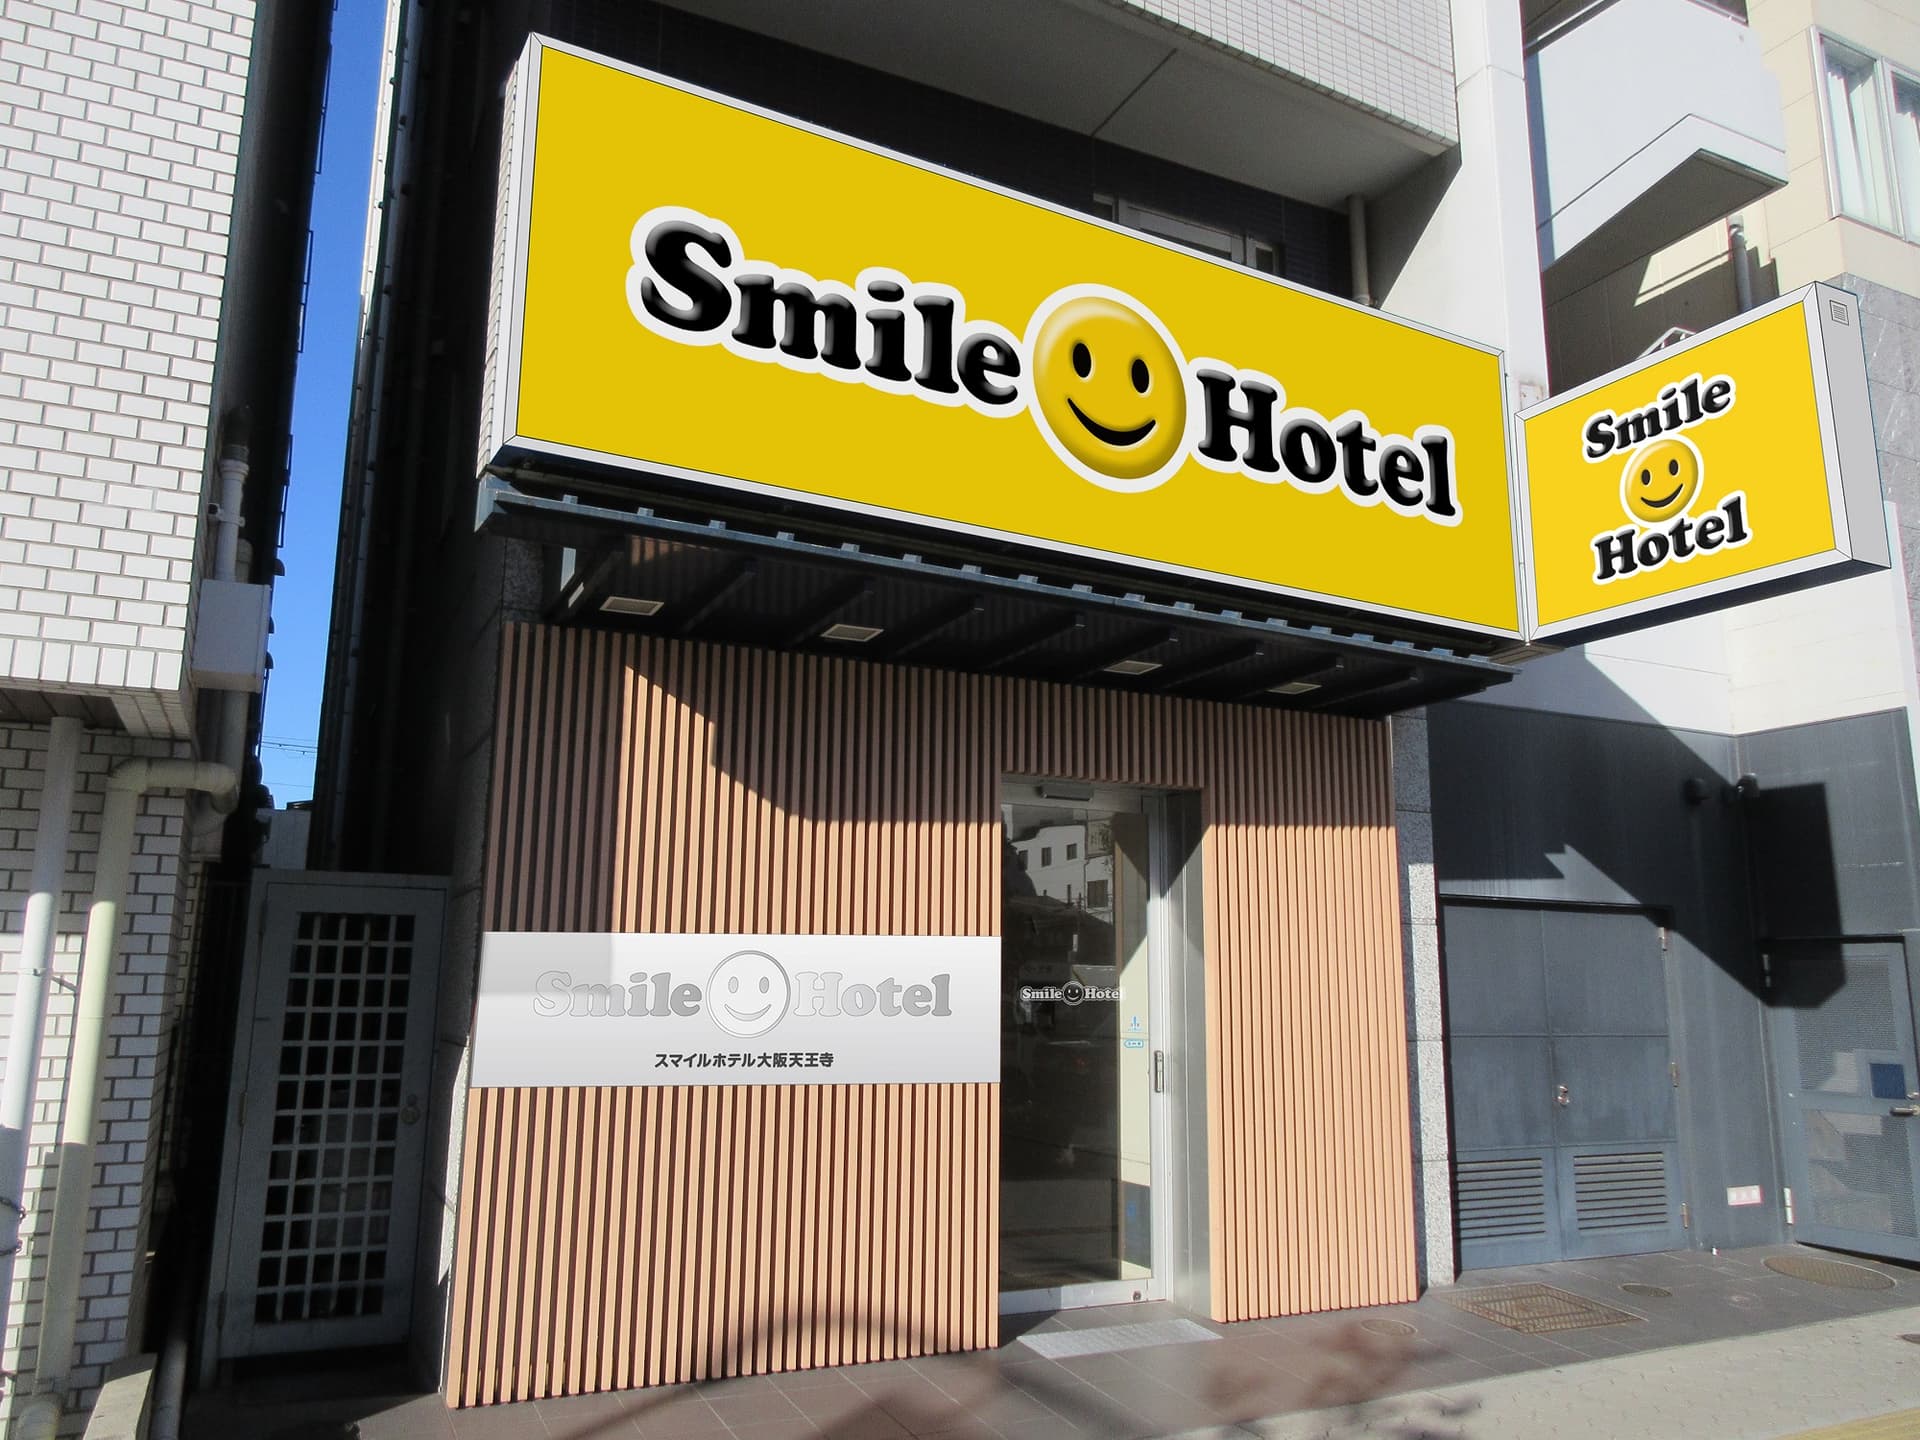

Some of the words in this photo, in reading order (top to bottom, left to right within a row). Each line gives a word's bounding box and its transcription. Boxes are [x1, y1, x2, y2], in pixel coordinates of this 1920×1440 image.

[641, 219, 1021, 405] Smile
[1196, 368, 1457, 517] Hotel
[1585, 378, 1731, 459] Smile
[1594, 495, 1748, 580] Hotel
[533, 970, 703, 1018] Smile
[793, 971, 953, 1017] Hotel
[1022, 988, 1062, 999] Smile
[655, 1052, 834, 1068] スマイルホテル大阪天王寺
